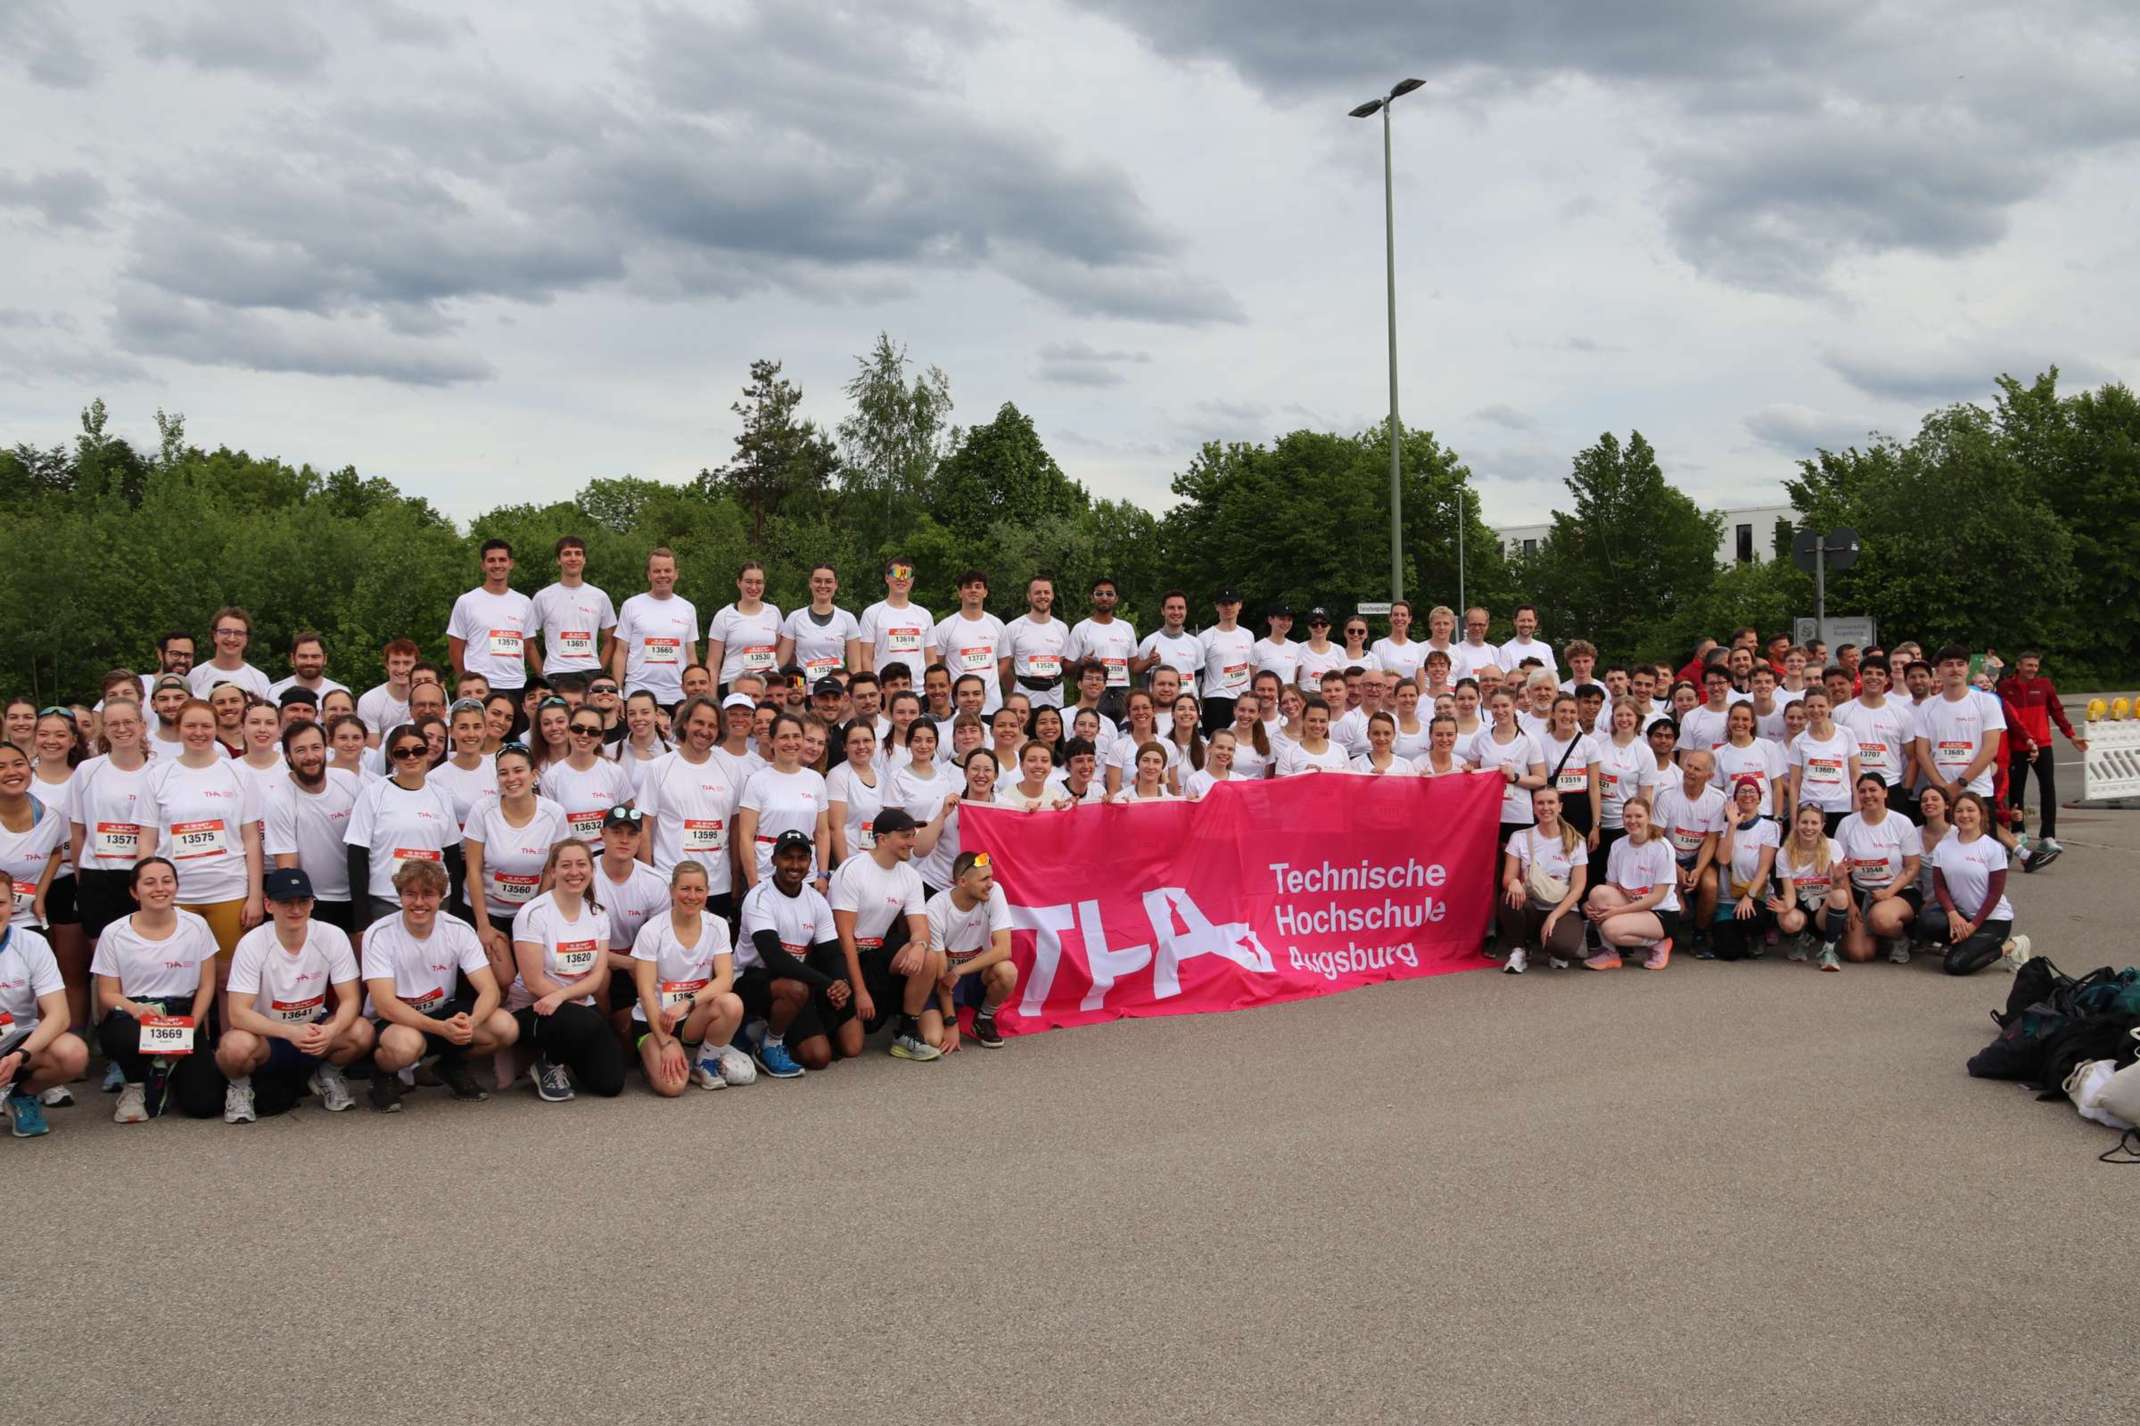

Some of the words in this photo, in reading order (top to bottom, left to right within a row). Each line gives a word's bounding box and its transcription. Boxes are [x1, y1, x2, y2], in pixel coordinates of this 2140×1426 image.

[106, 834, 138, 845] 13571
[182, 832, 215, 844] 13575
[1269, 858, 1447, 895] Technische
[502, 884, 531, 894] 13560
[1274, 896, 1447, 937] Hochschule
[566, 952, 592, 963] 13620
[1288, 942, 1419, 981] Augsburg
[282, 1008, 313, 1020] 13641
[151, 1028, 183, 1039] 13669
